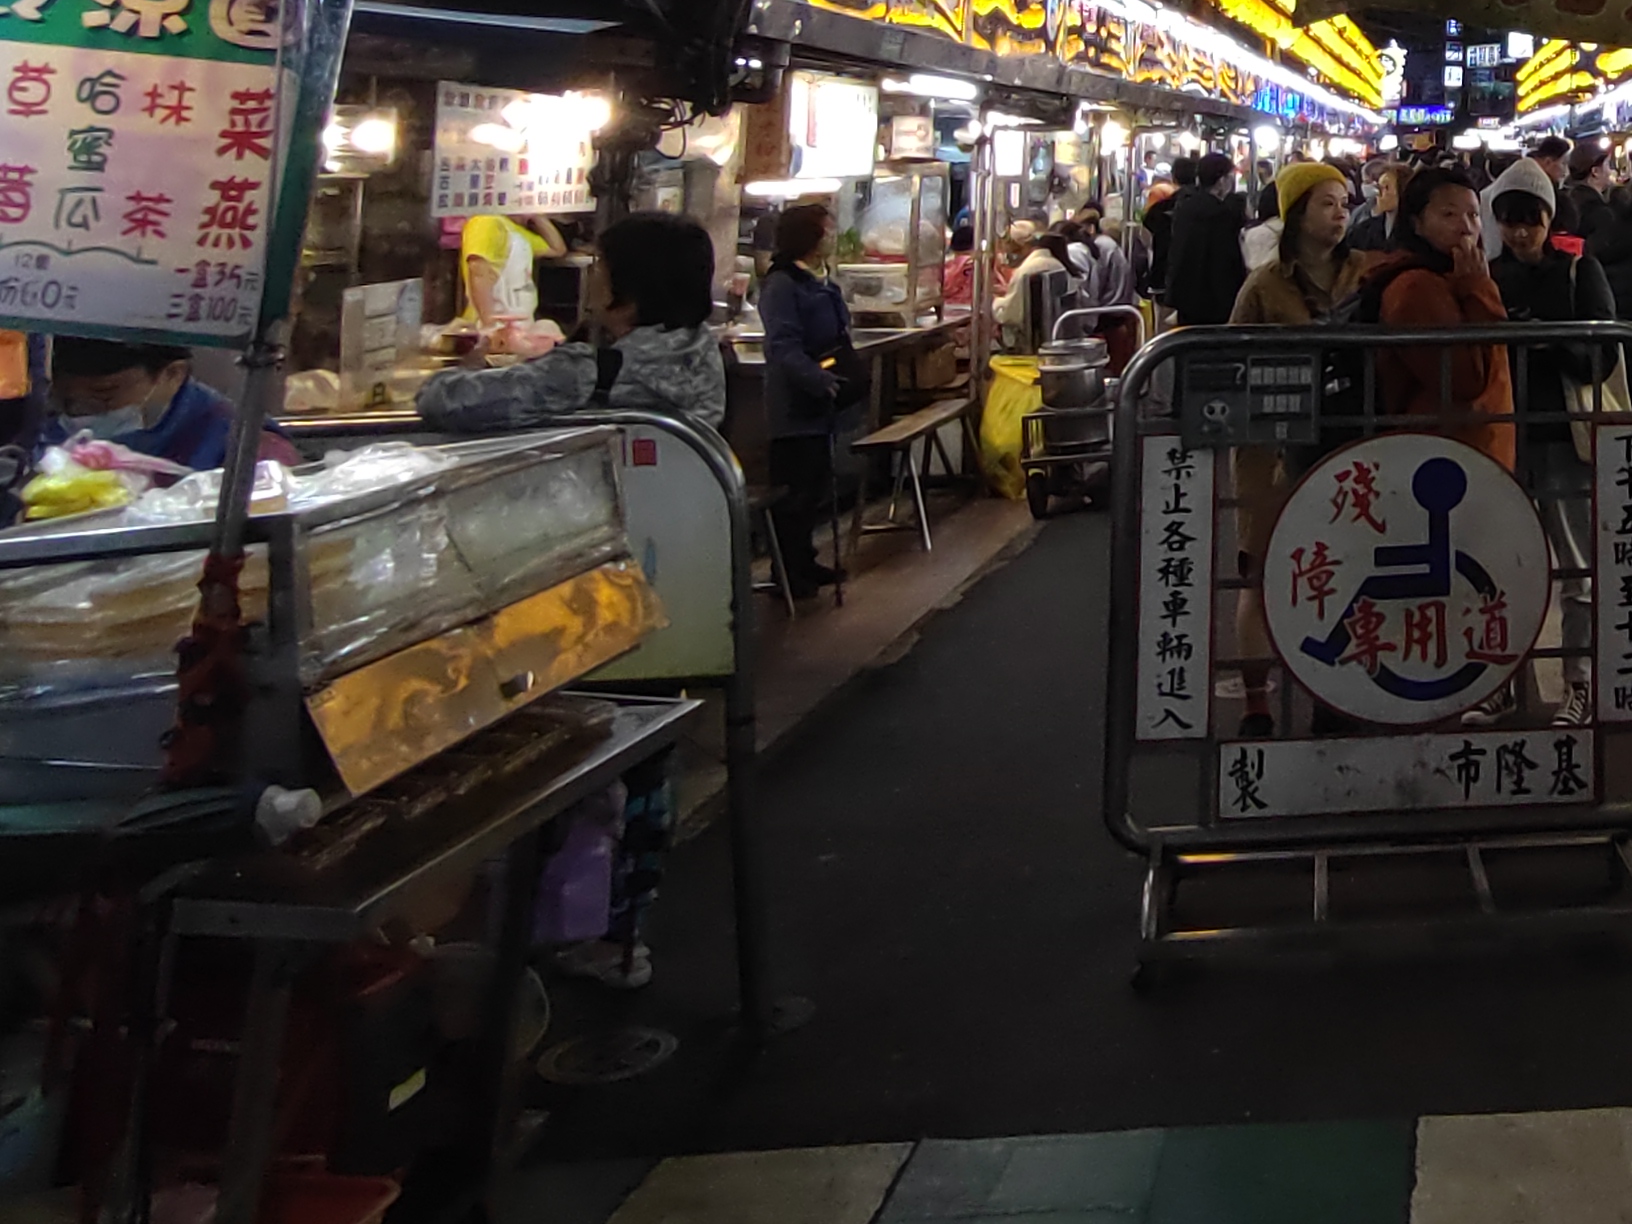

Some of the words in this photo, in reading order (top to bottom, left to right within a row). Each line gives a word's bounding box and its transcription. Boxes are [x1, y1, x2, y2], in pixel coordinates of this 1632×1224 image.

[54, 68, 127, 232] 哈蜜瓜
[121, 80, 196, 239] 抹茶
[1150, 445, 1196, 731] 禁止各種車輛進入
